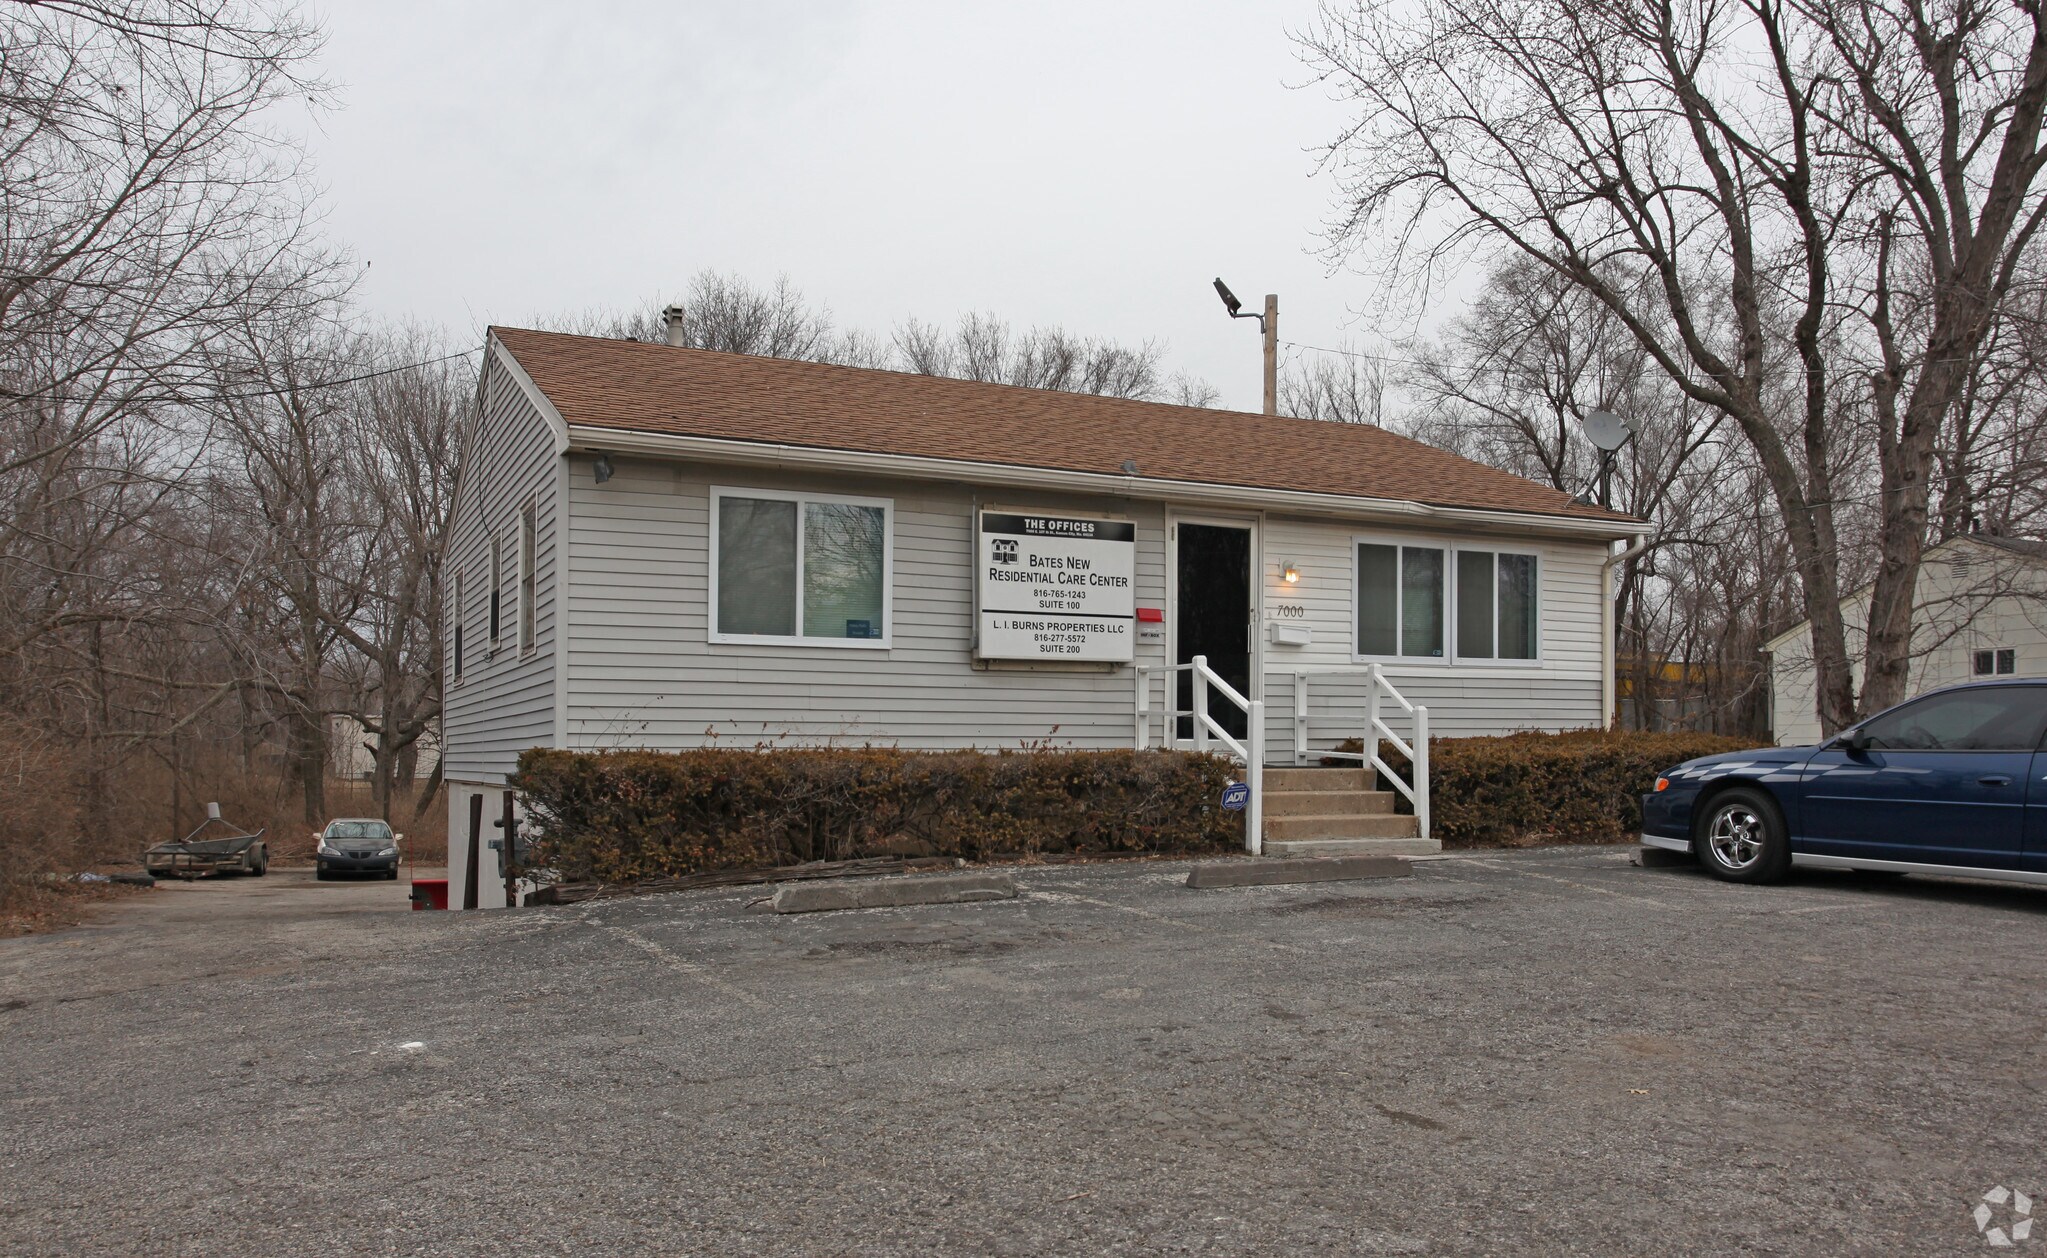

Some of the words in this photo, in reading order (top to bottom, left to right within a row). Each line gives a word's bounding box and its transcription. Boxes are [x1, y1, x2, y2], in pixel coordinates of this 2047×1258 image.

[1024, 518, 1046, 530] THE
[1048, 520, 1095, 533] OFFICES
[1029, 554, 1064, 569] BATES
[1066, 556, 1091, 570] NEW
[989, 567, 1055, 584] RESIDENTIAL
[1057, 571, 1086, 586] CARE
[1089, 572, 1129, 588] CENTER
[1033, 588, 1087, 599] 816-765-1243
[1039, 599, 1064, 609] SUITE
[1066, 601, 1081, 610] 100
[1277, 605, 1304, 618] 7000
[993, 620, 1002, 629] L.
[1004, 620, 1010, 629] I.
[1012, 620, 1045, 631] BURNS
[1047, 622, 1105, 633] PROPERTIES
[1107, 624, 1125, 634] LLC
[1034, 633, 1086, 643] 816-277-5572
[1039, 644, 1065, 653] SUITE
[1066, 645, 1081, 654] 200
[1226, 791, 1246, 803] ADT
